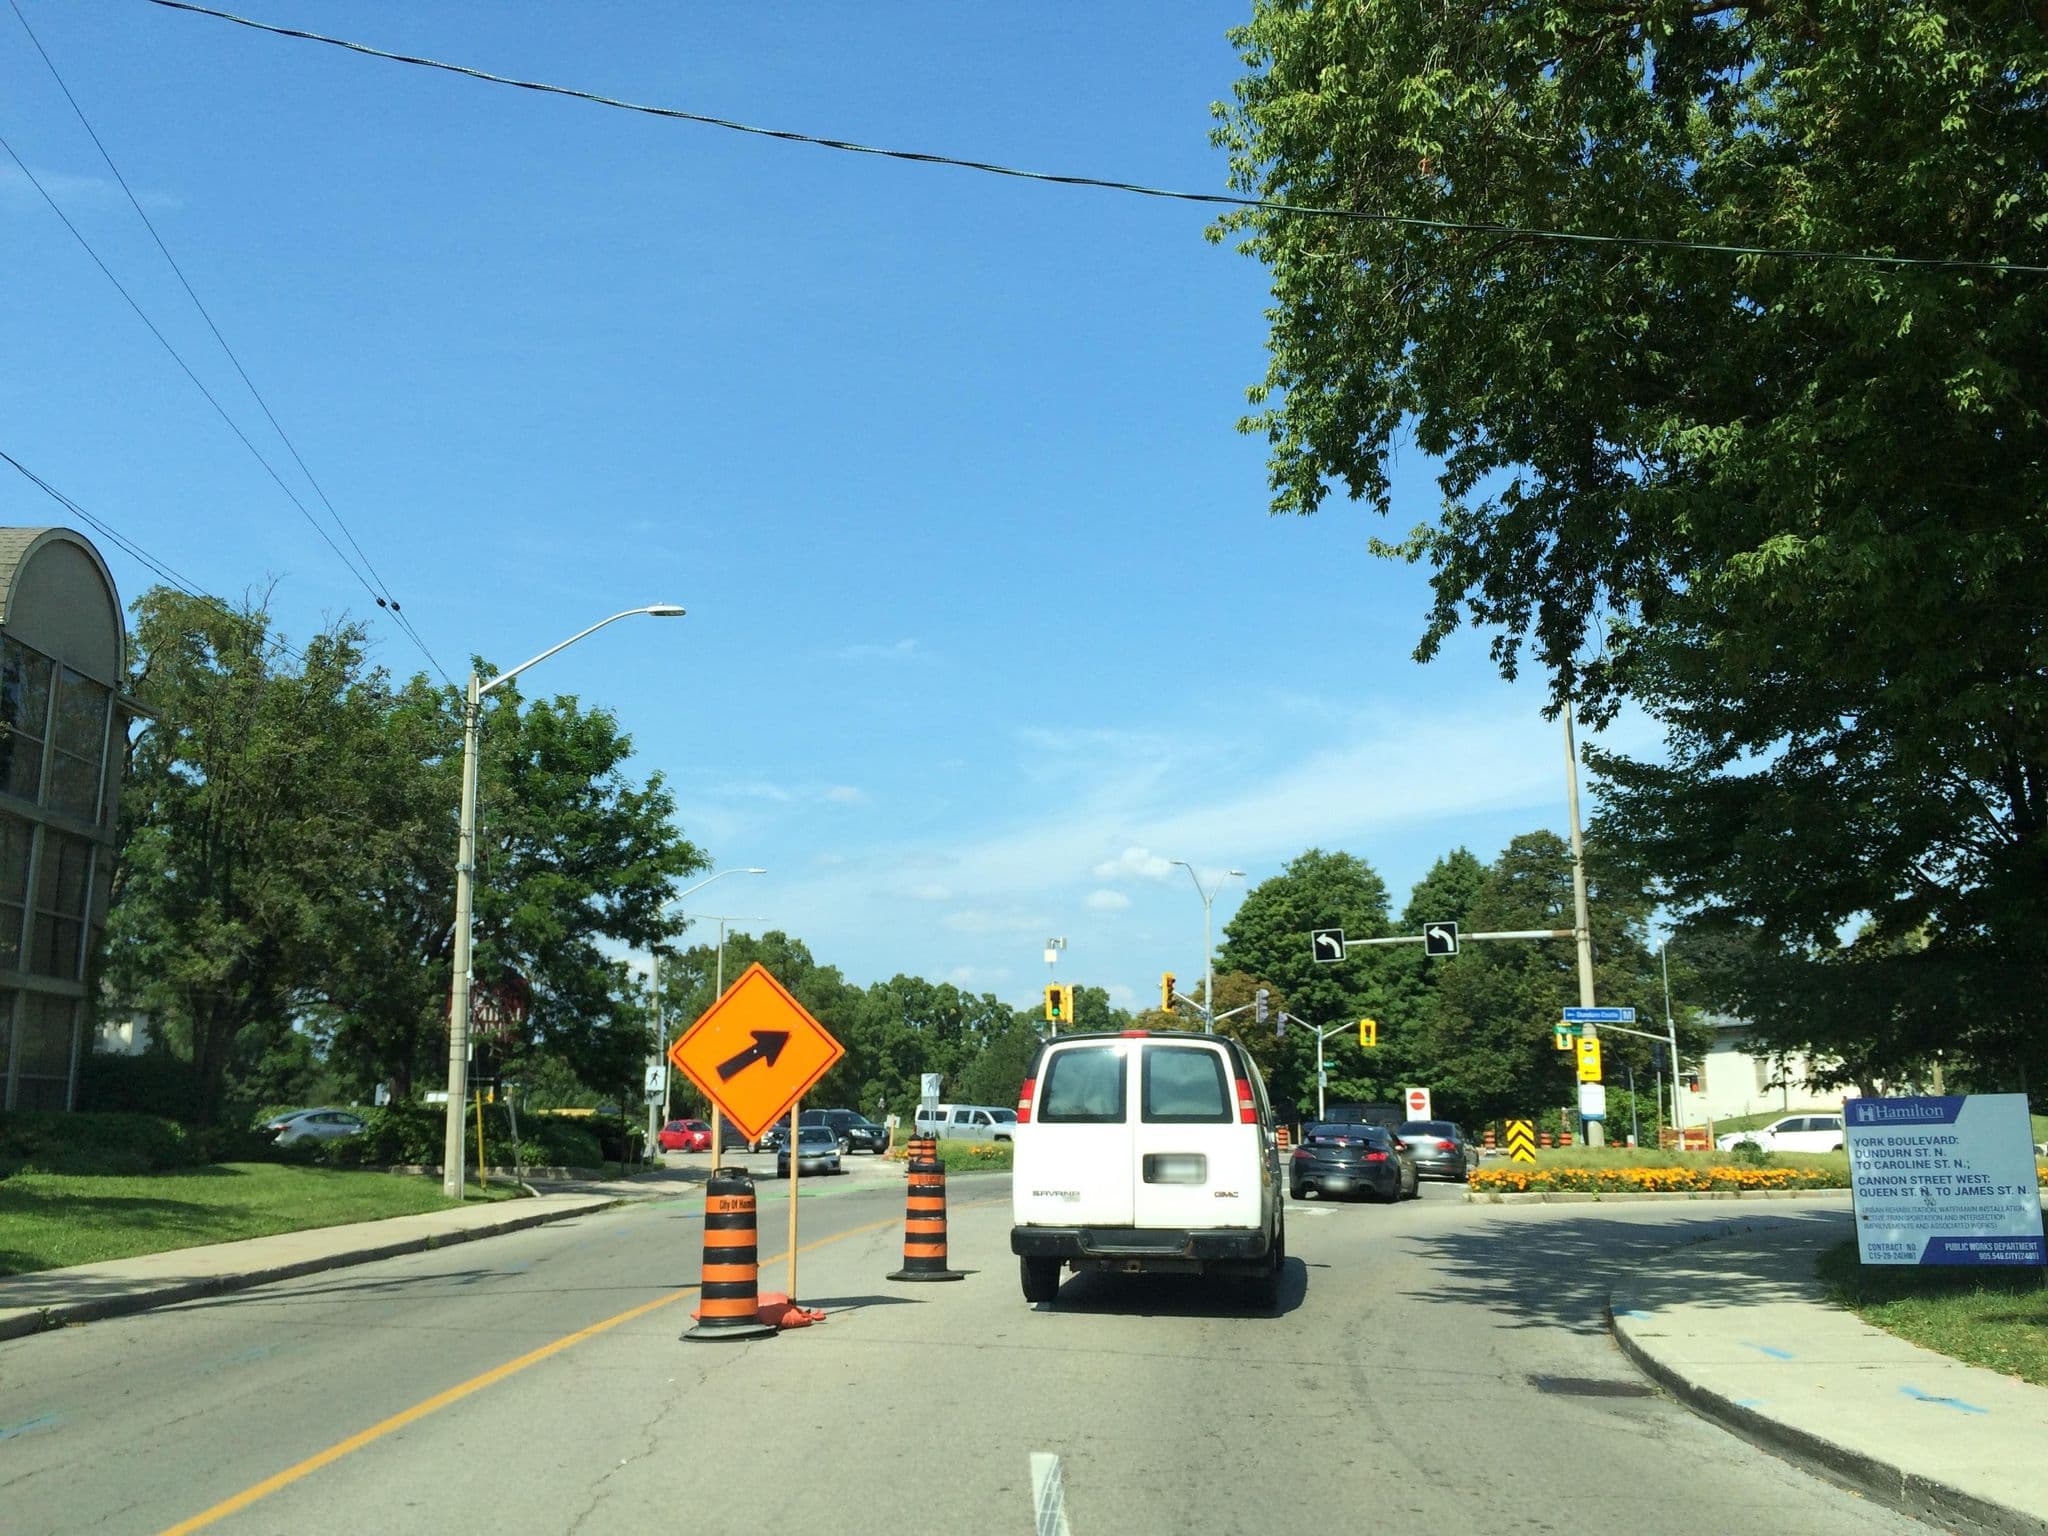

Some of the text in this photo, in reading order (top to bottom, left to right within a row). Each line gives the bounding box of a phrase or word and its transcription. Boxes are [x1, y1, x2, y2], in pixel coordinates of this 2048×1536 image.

[1876, 1104, 1944, 1118] Hamilton
[1854, 1136, 1959, 1147] YORK BOULEVARD:
[1855, 1148, 1946, 1158] DUNDURN ST. N.
[1856, 1161, 1871, 1170] TO
[1874, 1160, 1931, 1169] CAROLINE
[1934, 1160, 1950, 1169] ST.
[1858, 1176, 1907, 1185] CANNON
[1910, 1175, 1951, 1185] STREET
[1859, 1188, 1897, 1197] QUEEN
[1901, 1187, 1917, 1197] ST.
[1936, 1187, 1951, 1196] TO
[1955, 1186, 1994, 1196] JAMES
[1997, 1185, 2014, 1195] ST.
[2017, 1185, 2030, 1195] N.
[1867, 1243, 1903, 1251] CONTRACT
[1945, 1242, 2038, 1251] PUBLIC WORKS DEPARTMENT
